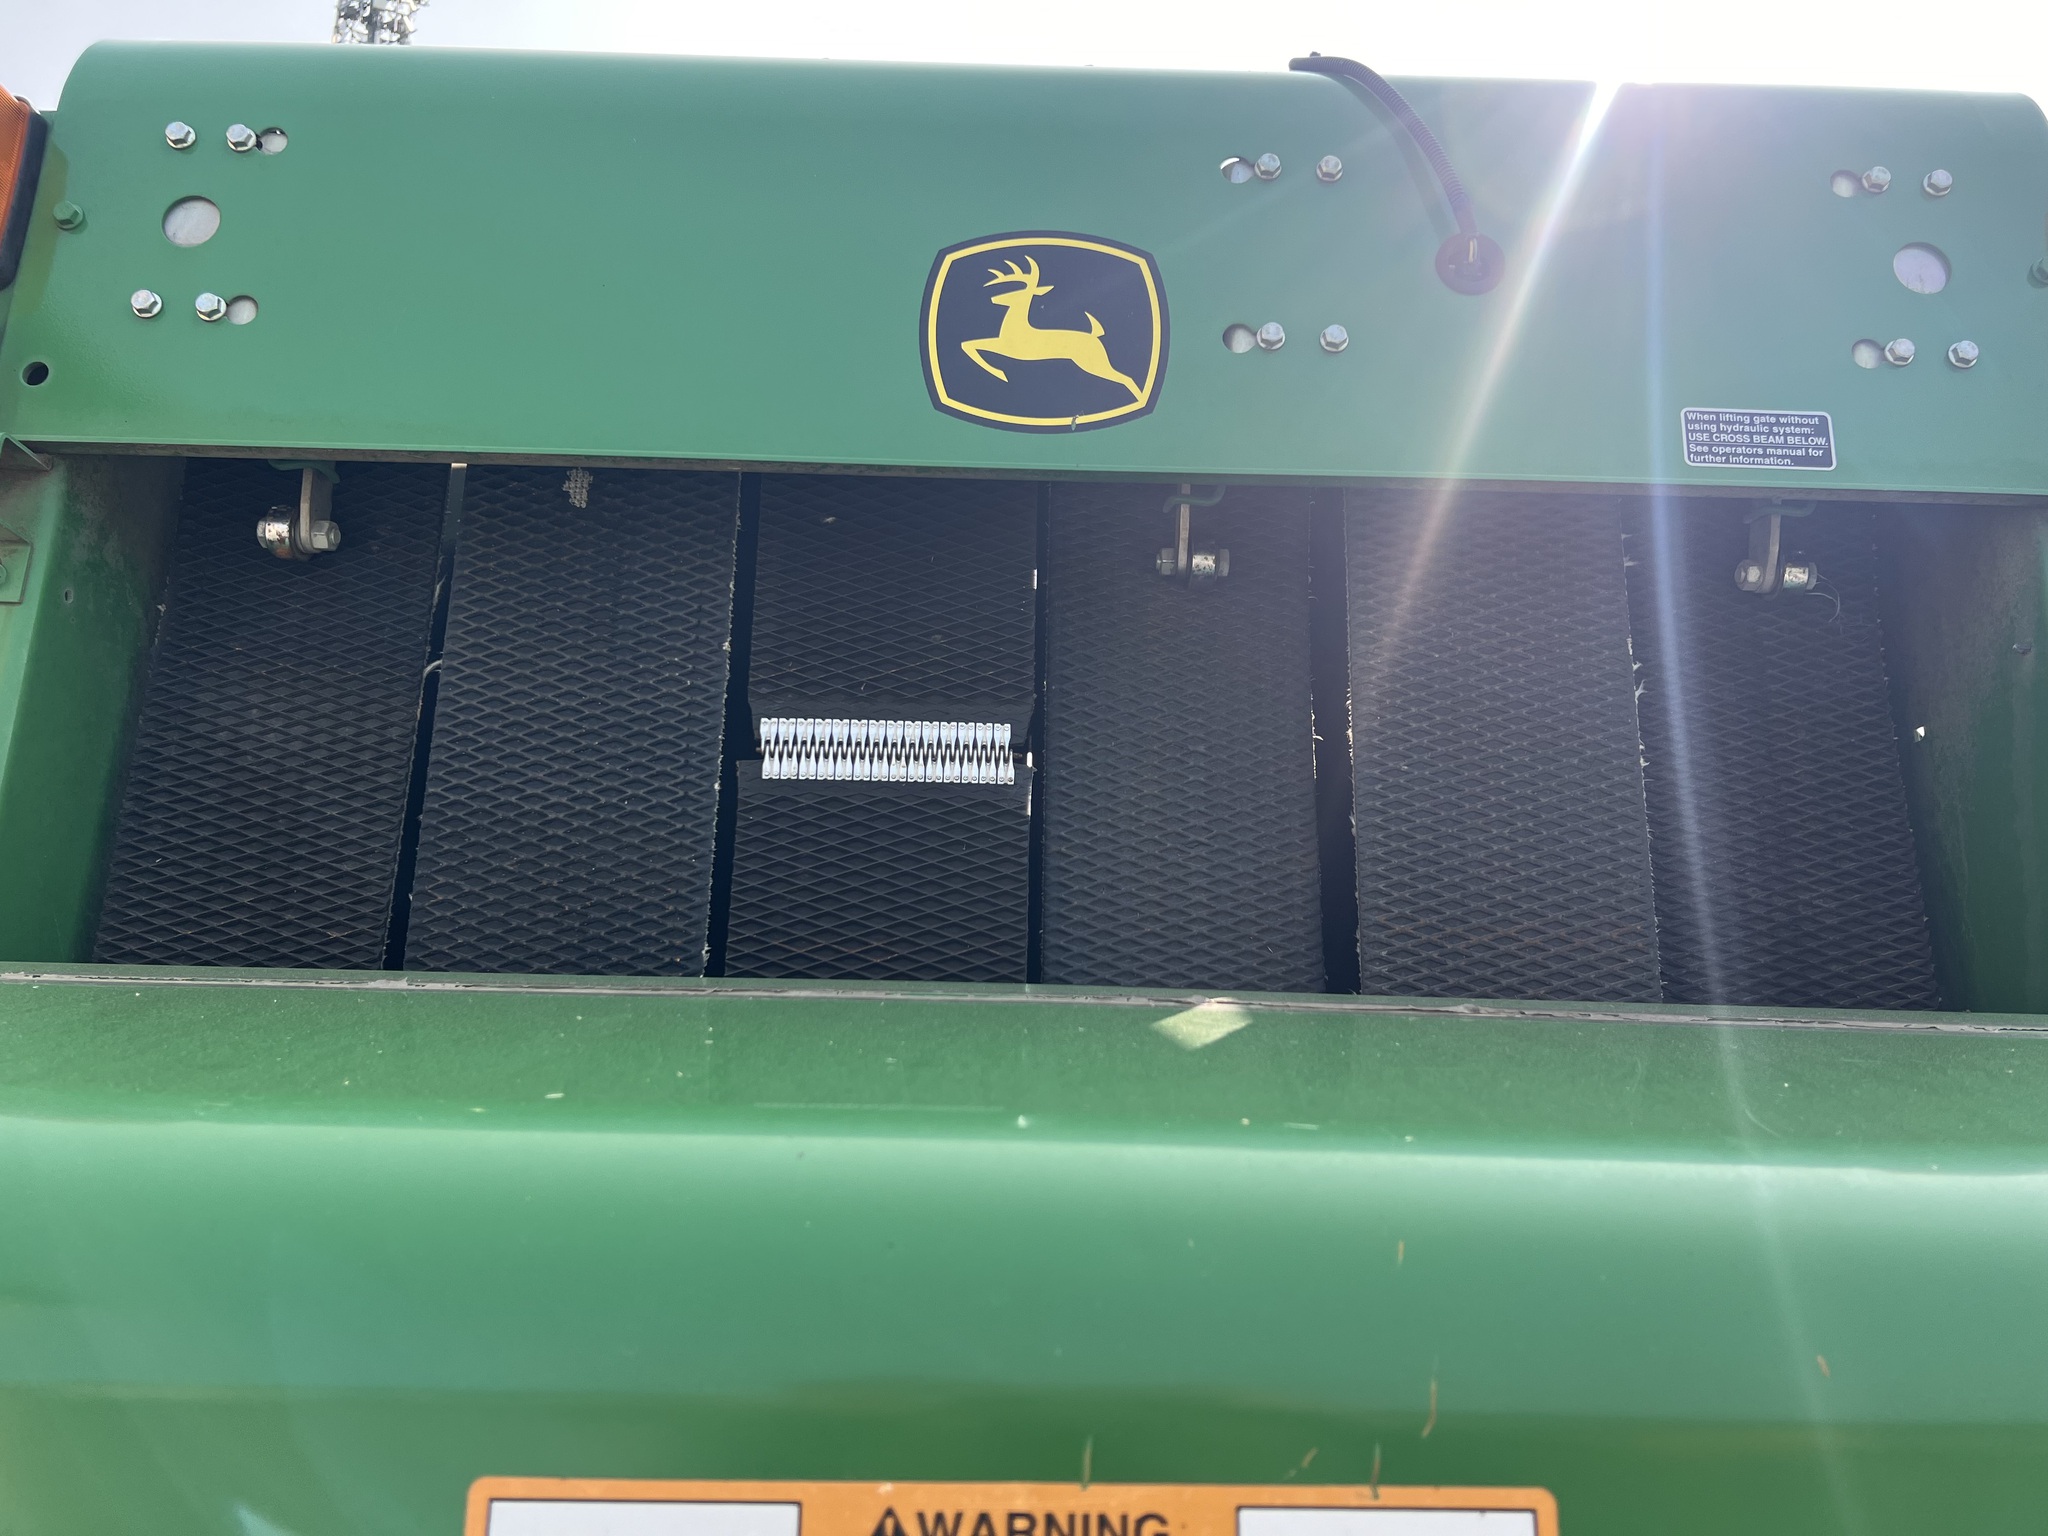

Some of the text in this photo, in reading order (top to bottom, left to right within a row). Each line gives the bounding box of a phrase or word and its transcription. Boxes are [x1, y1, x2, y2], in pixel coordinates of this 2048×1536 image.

[1686, 412, 1819, 424] When lifting gate without
[1688, 422, 1815, 434] using hydraulic system:
[1688, 433, 1828, 446] USE CROSS BEAM BELOW.
[1690, 444, 1824, 456] See operators manual for
[1690, 454, 1794, 466] further information.
[916, 1511, 1170, 1536] WARNING
